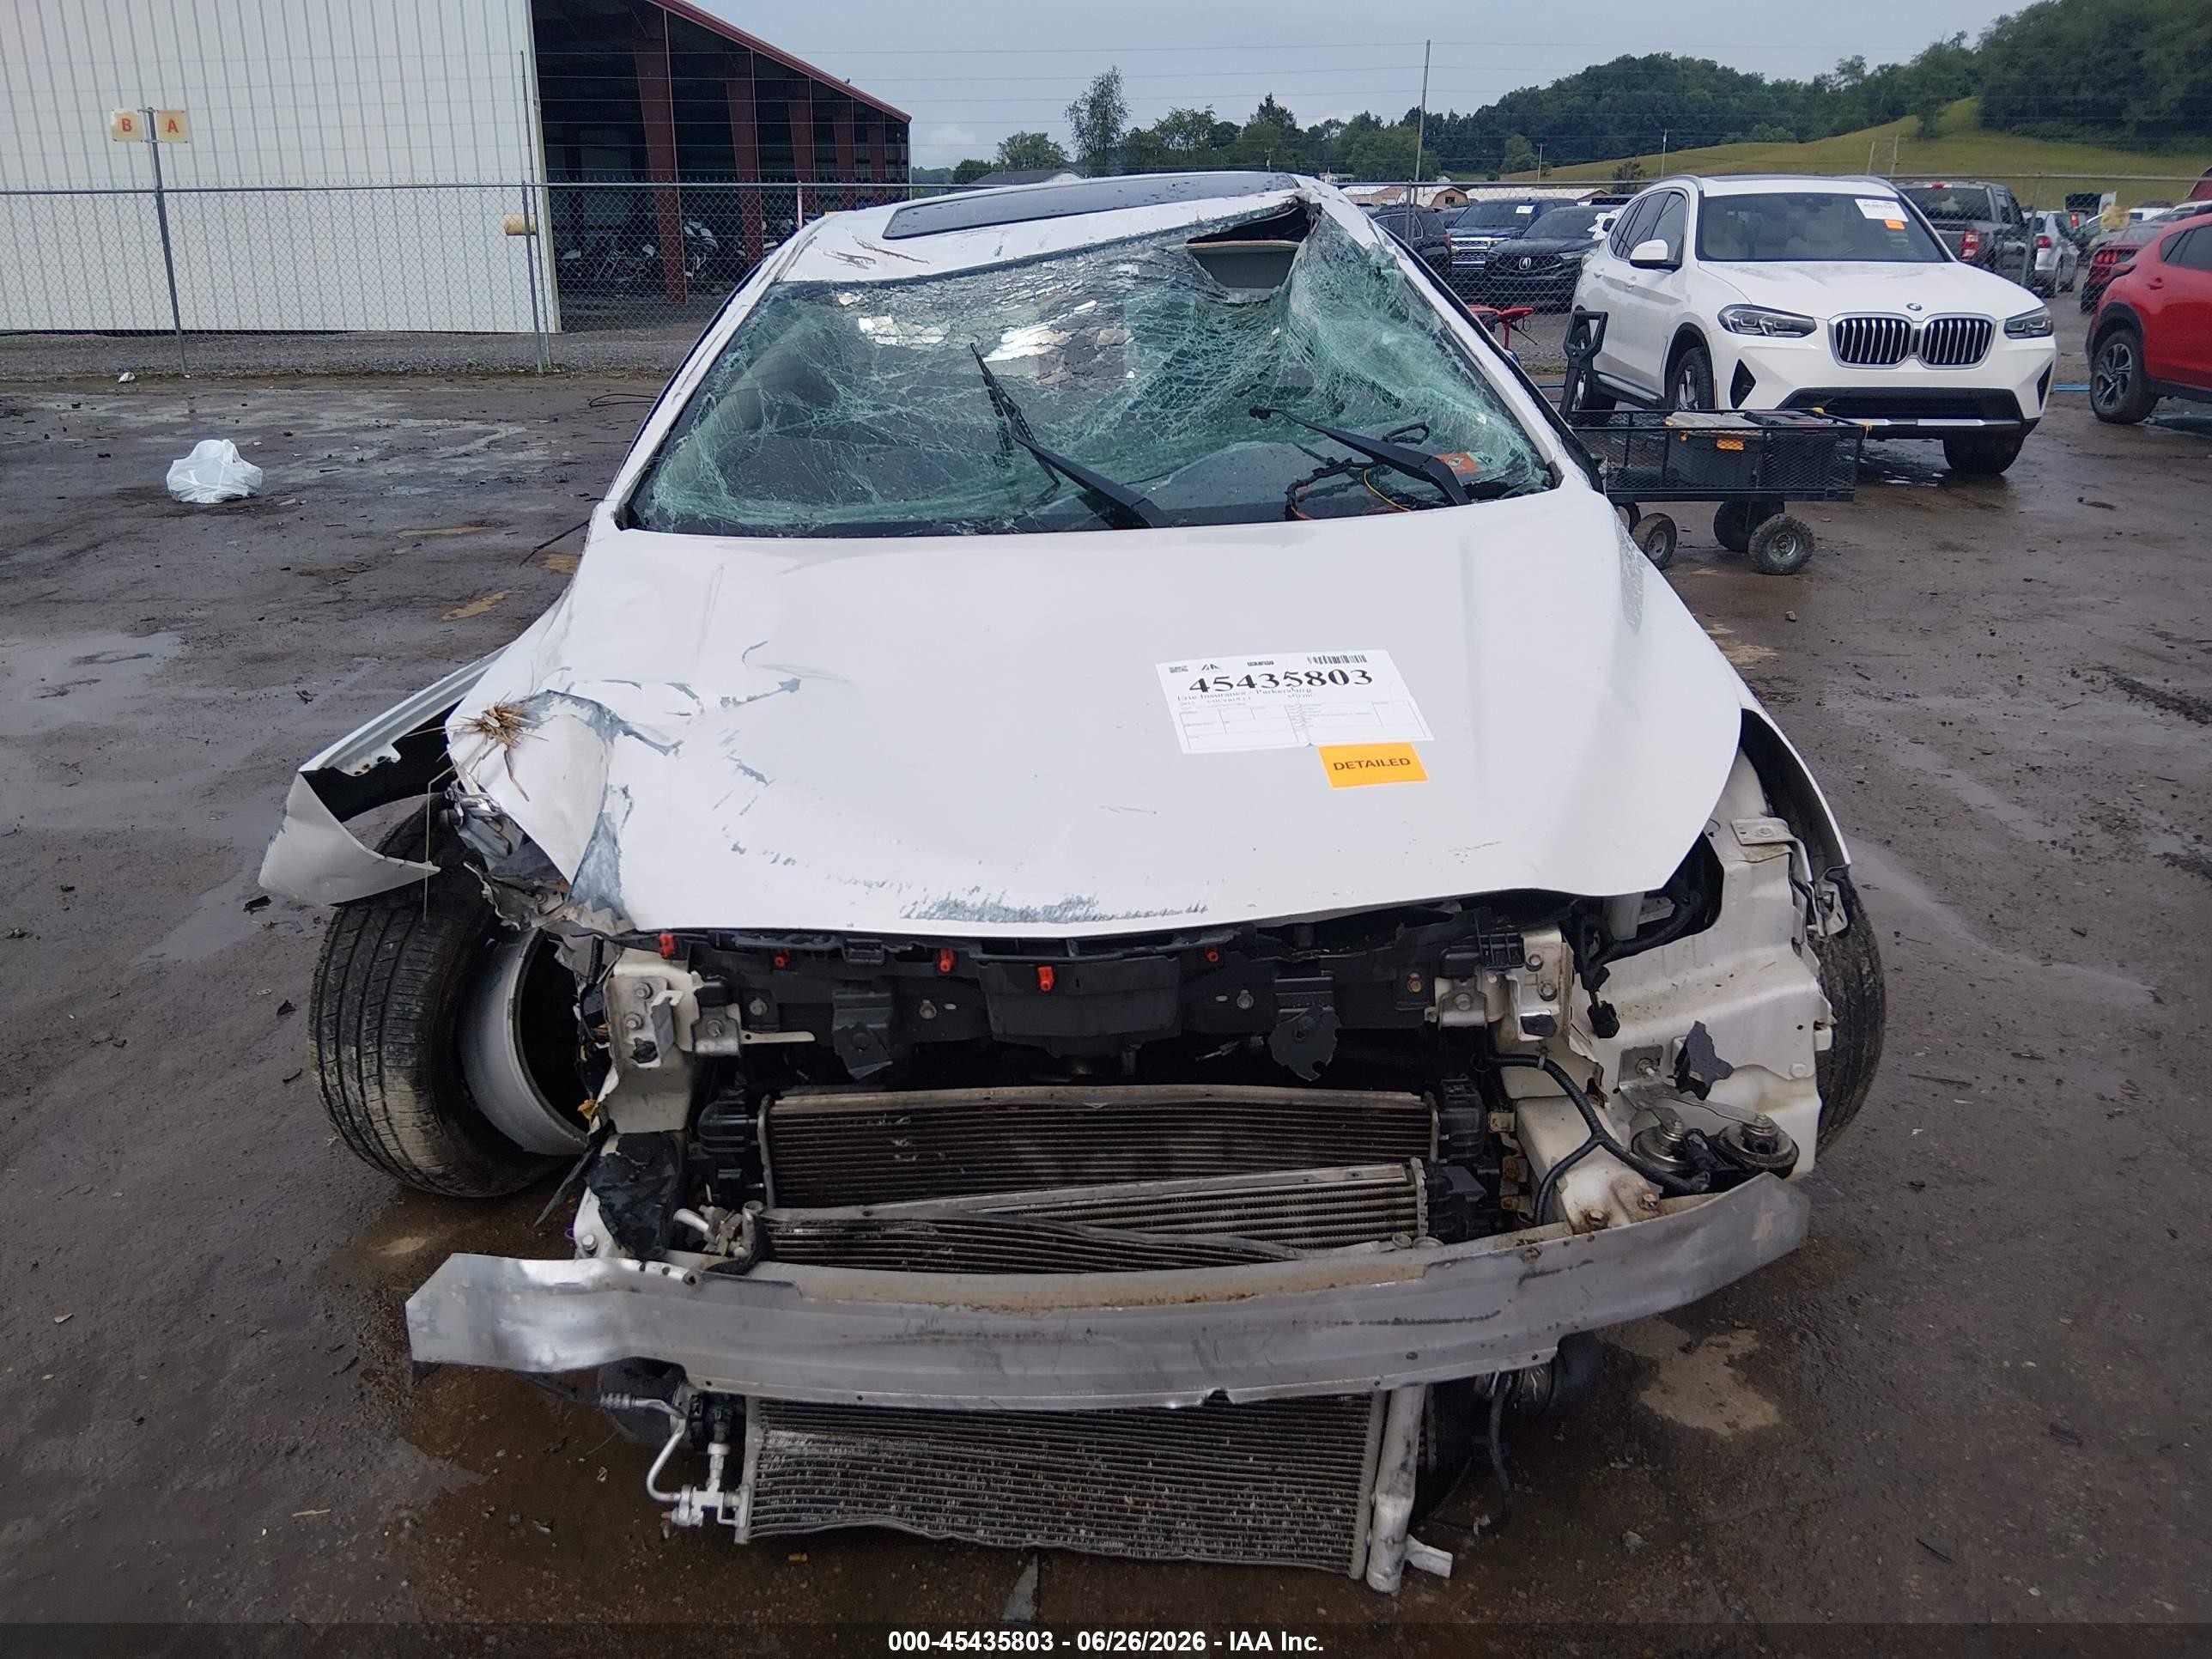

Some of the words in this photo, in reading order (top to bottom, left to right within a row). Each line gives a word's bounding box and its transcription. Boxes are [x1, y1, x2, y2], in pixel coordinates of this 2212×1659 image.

[122, 118, 132, 131] B
[167, 118, 179, 133] A
[1189, 668, 1372, 693] 45435803
[1333, 757, 1412, 771] DETAILED
